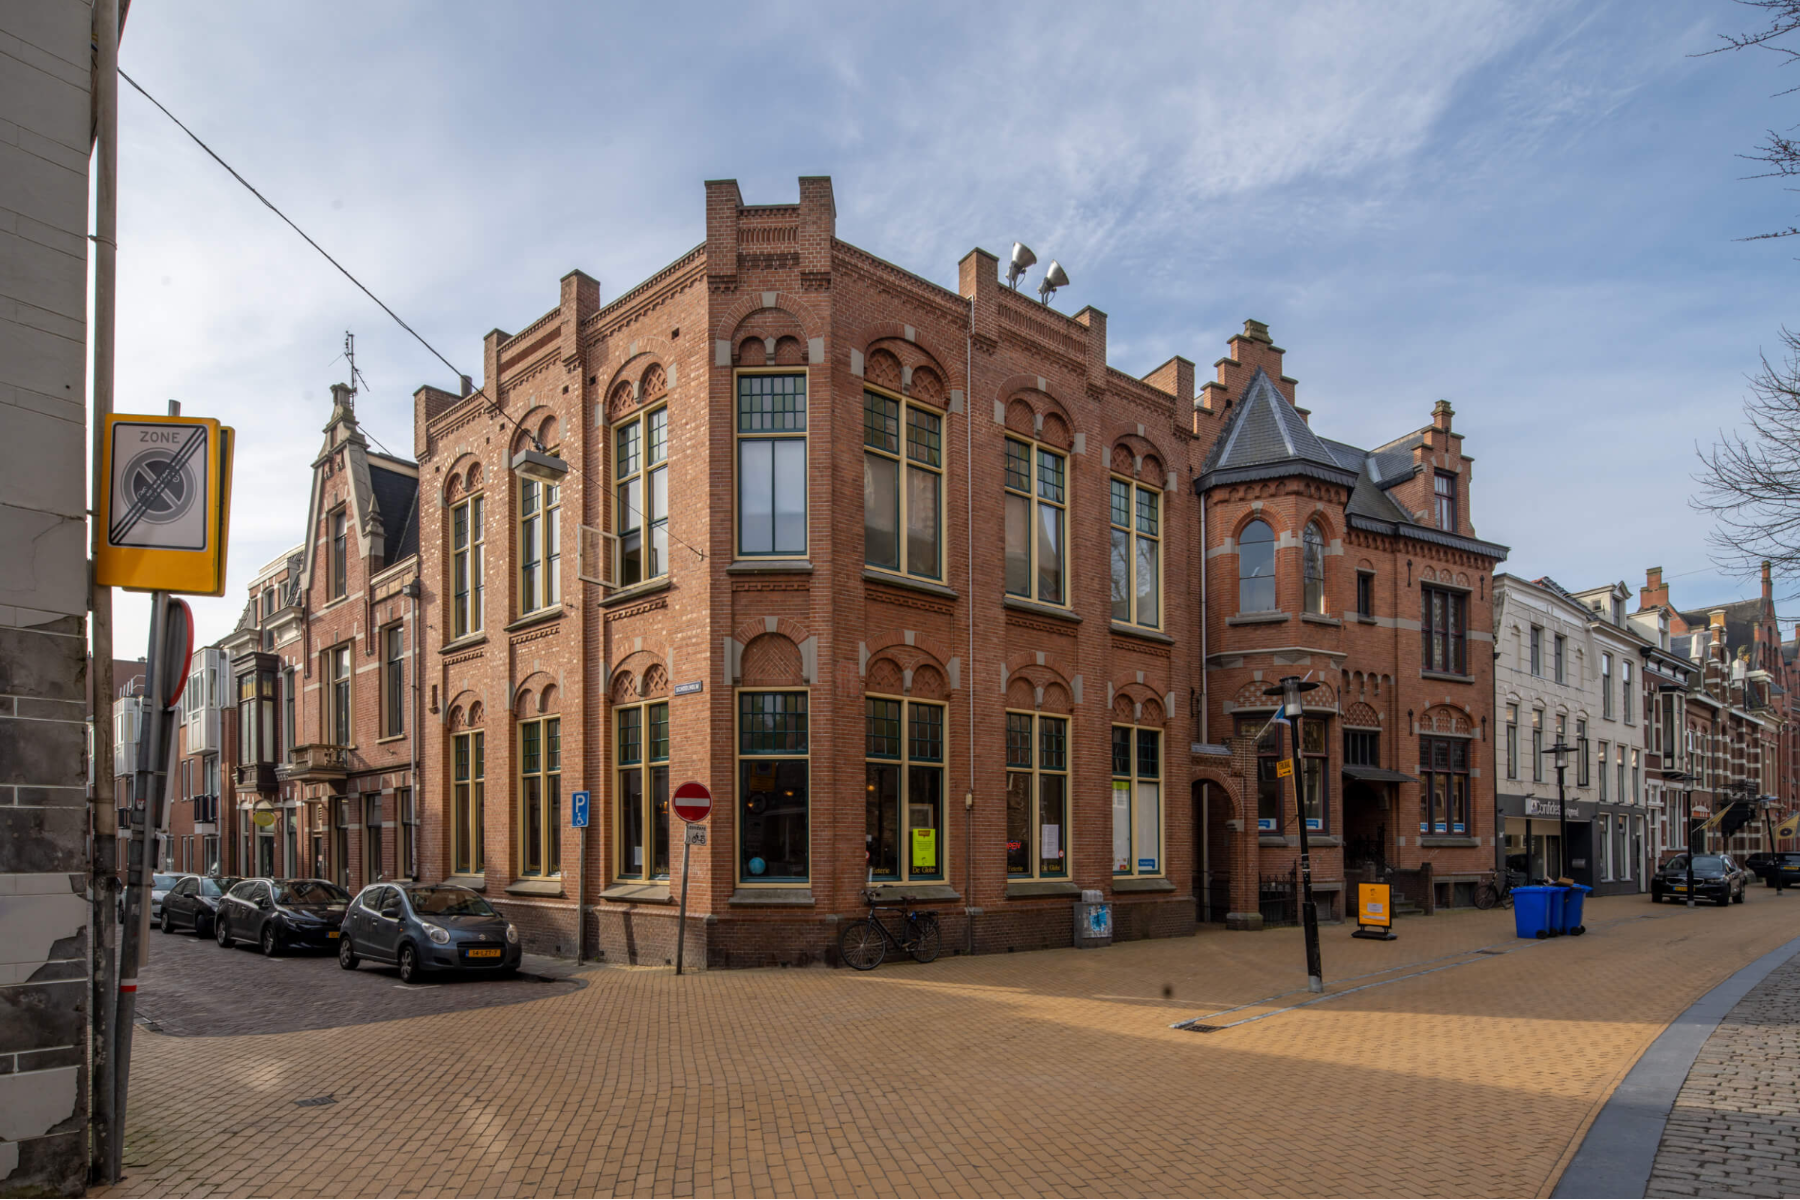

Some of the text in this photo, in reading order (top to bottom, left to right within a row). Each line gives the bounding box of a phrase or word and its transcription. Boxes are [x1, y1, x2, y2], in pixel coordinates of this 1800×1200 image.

[140, 431, 180, 443] ZONE
[576, 794, 586, 813] P
[1007, 842, 1021, 850] PEN
